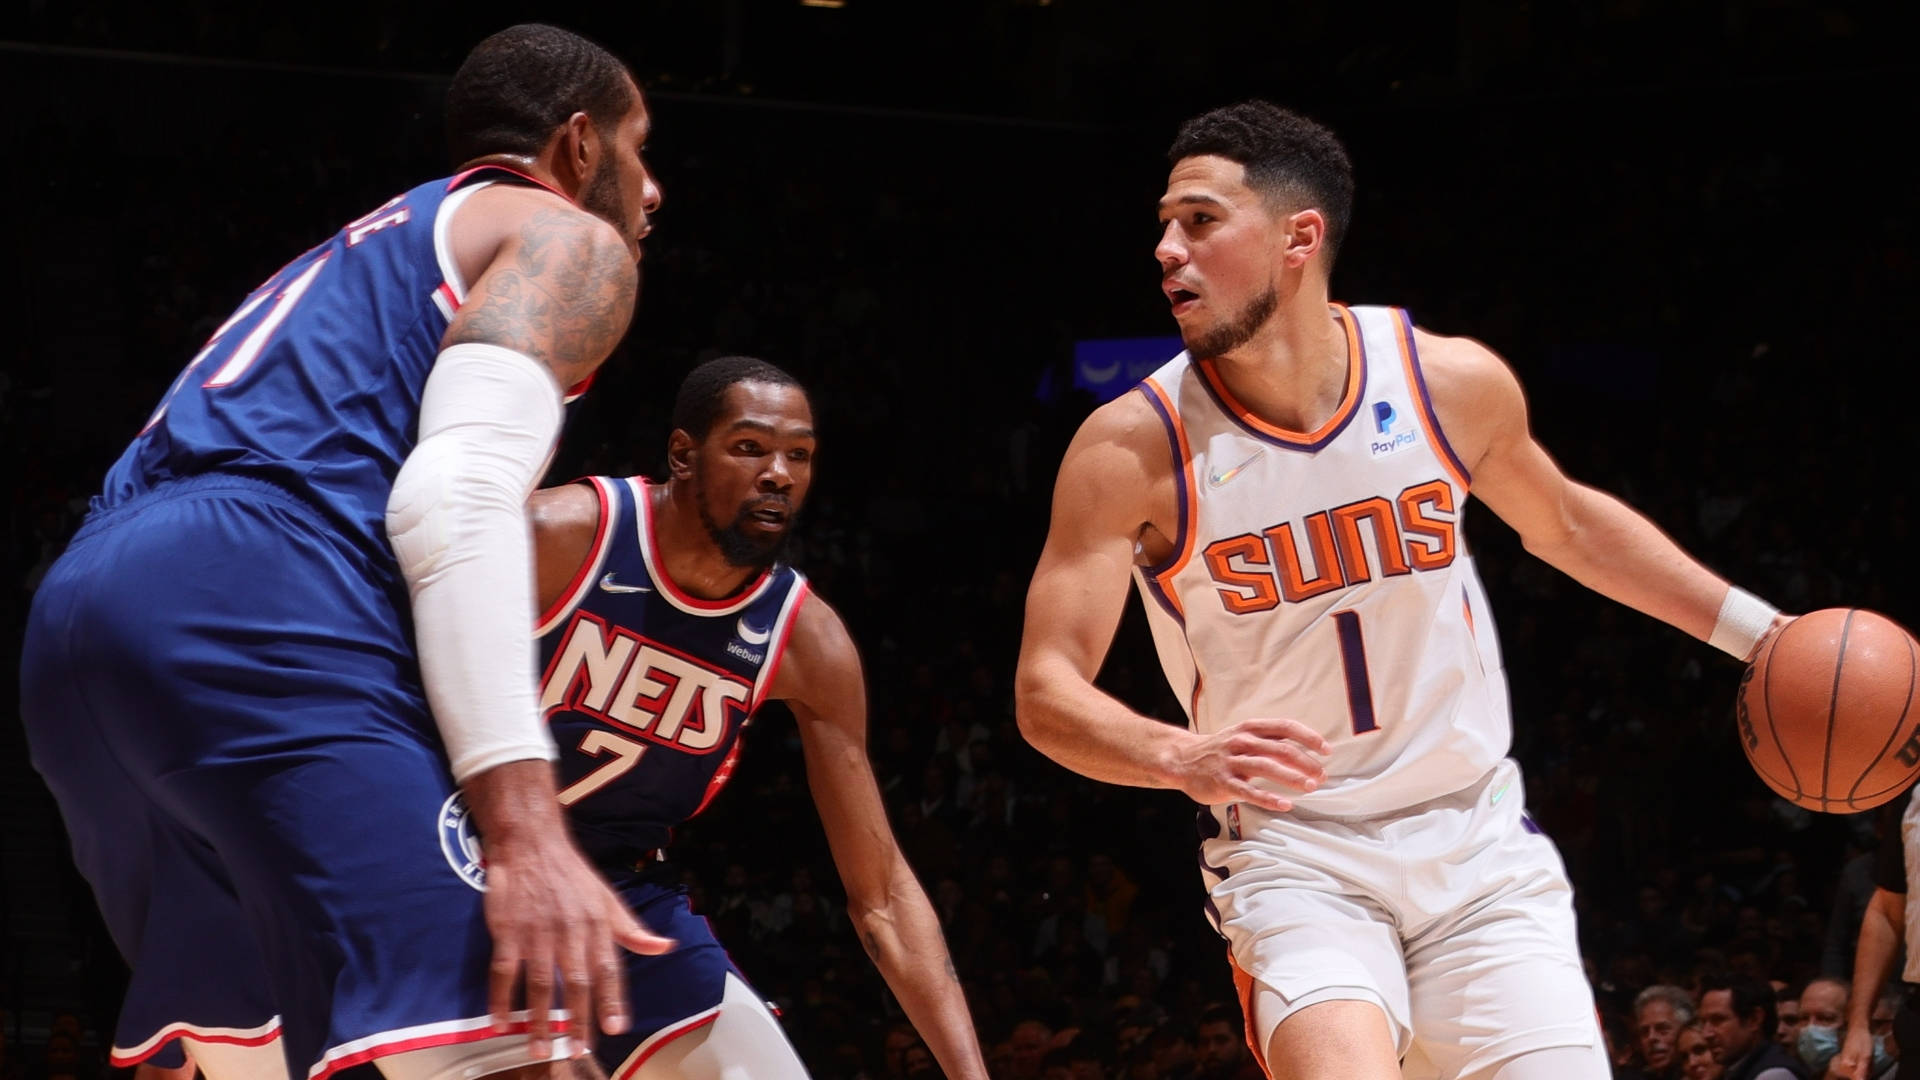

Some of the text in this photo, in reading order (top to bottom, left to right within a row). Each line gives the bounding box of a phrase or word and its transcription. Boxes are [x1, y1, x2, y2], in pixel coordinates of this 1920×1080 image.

[1371, 430, 1416, 455] PayPal
[1203, 479, 1455, 615] SUNS
[541, 611, 755, 753] NETS
[727, 642, 761, 664] Webull
[1332, 609, 1381, 735] 1
[556, 729, 648, 808] 7
